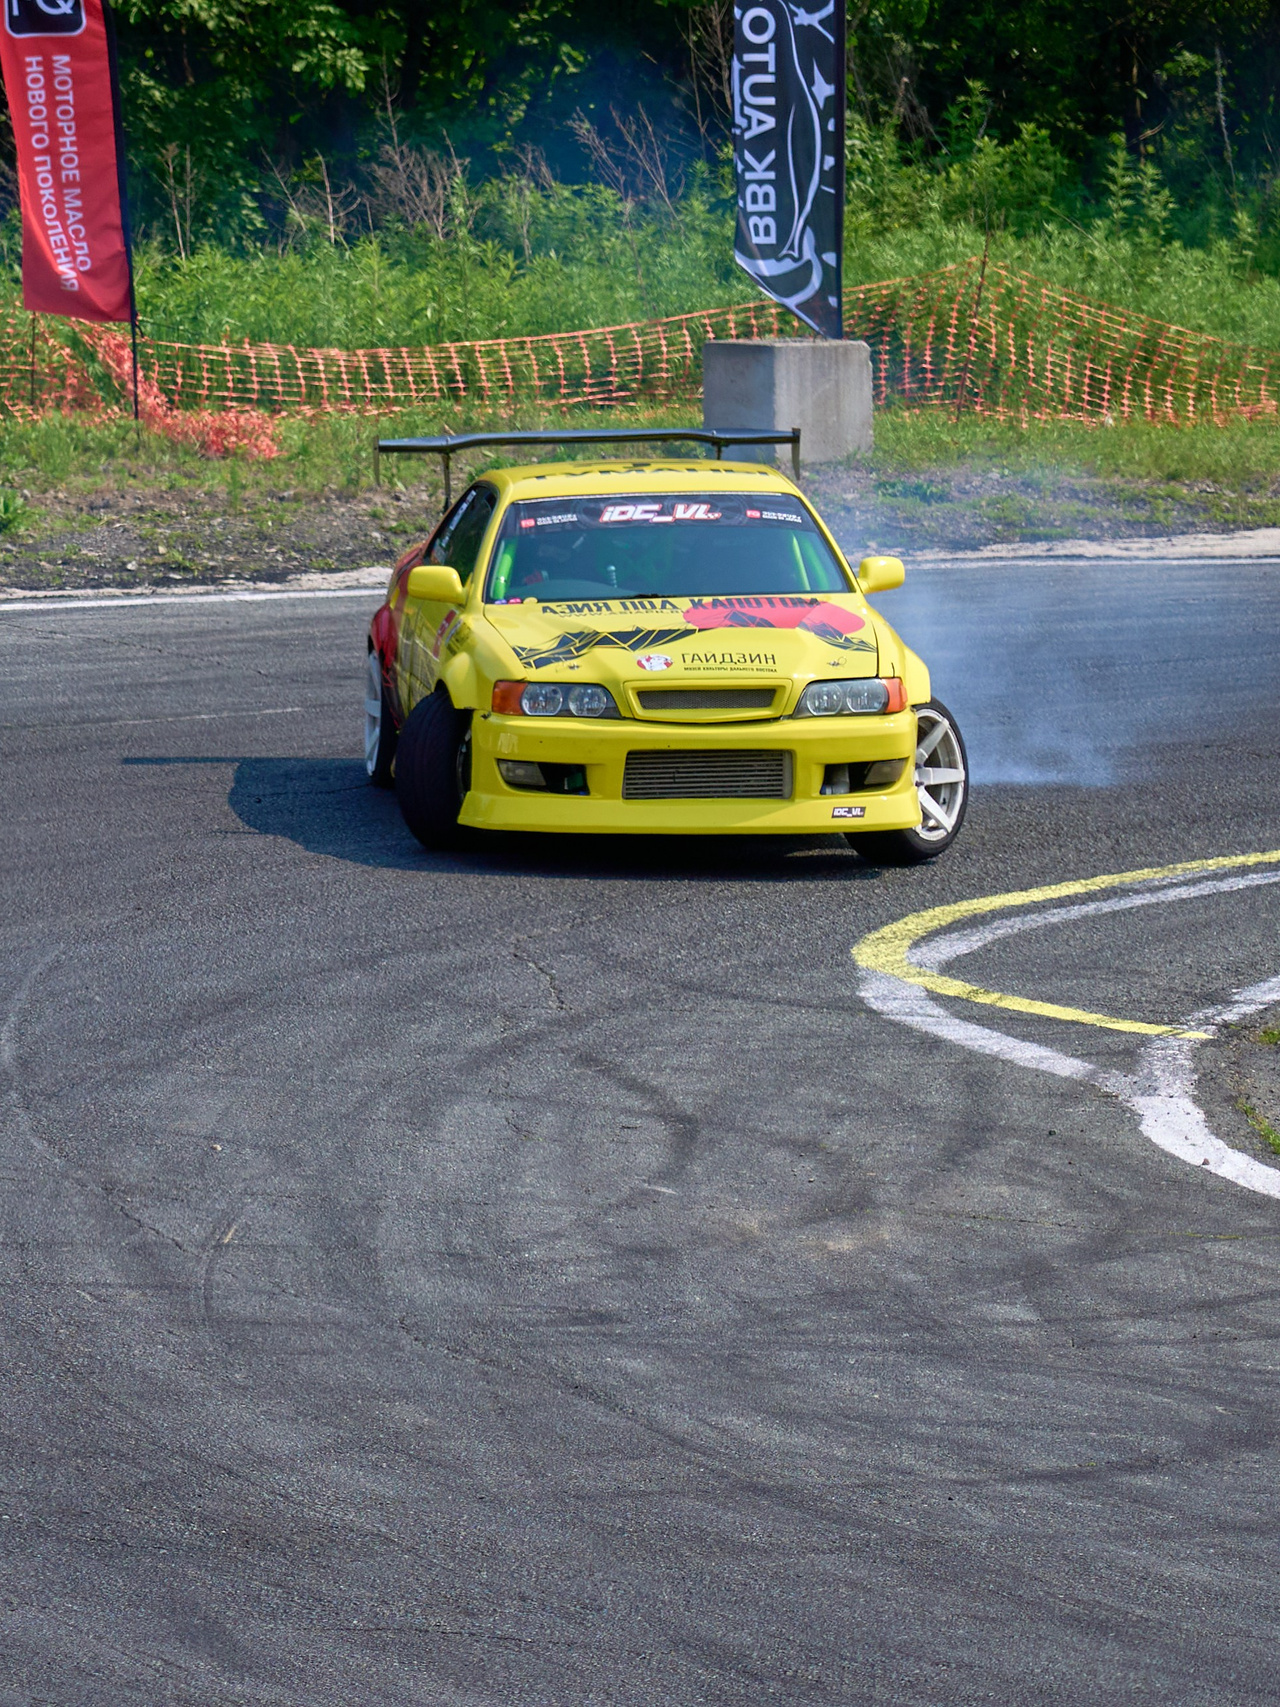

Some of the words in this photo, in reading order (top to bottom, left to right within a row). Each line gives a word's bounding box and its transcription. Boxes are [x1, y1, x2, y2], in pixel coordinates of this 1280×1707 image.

[24, 56, 50, 149] НОВОГО
[52, 54, 81, 182] МОТОРНОЕ
[34, 156, 80, 292] ПОКОЛЕНИЯ
[64, 188, 92, 272] МАСЛО
[744, 149, 777, 245] BBK
[542, 601, 612, 614] АЗИЯ
[682, 651, 776, 664] ГАЙДЗИН
